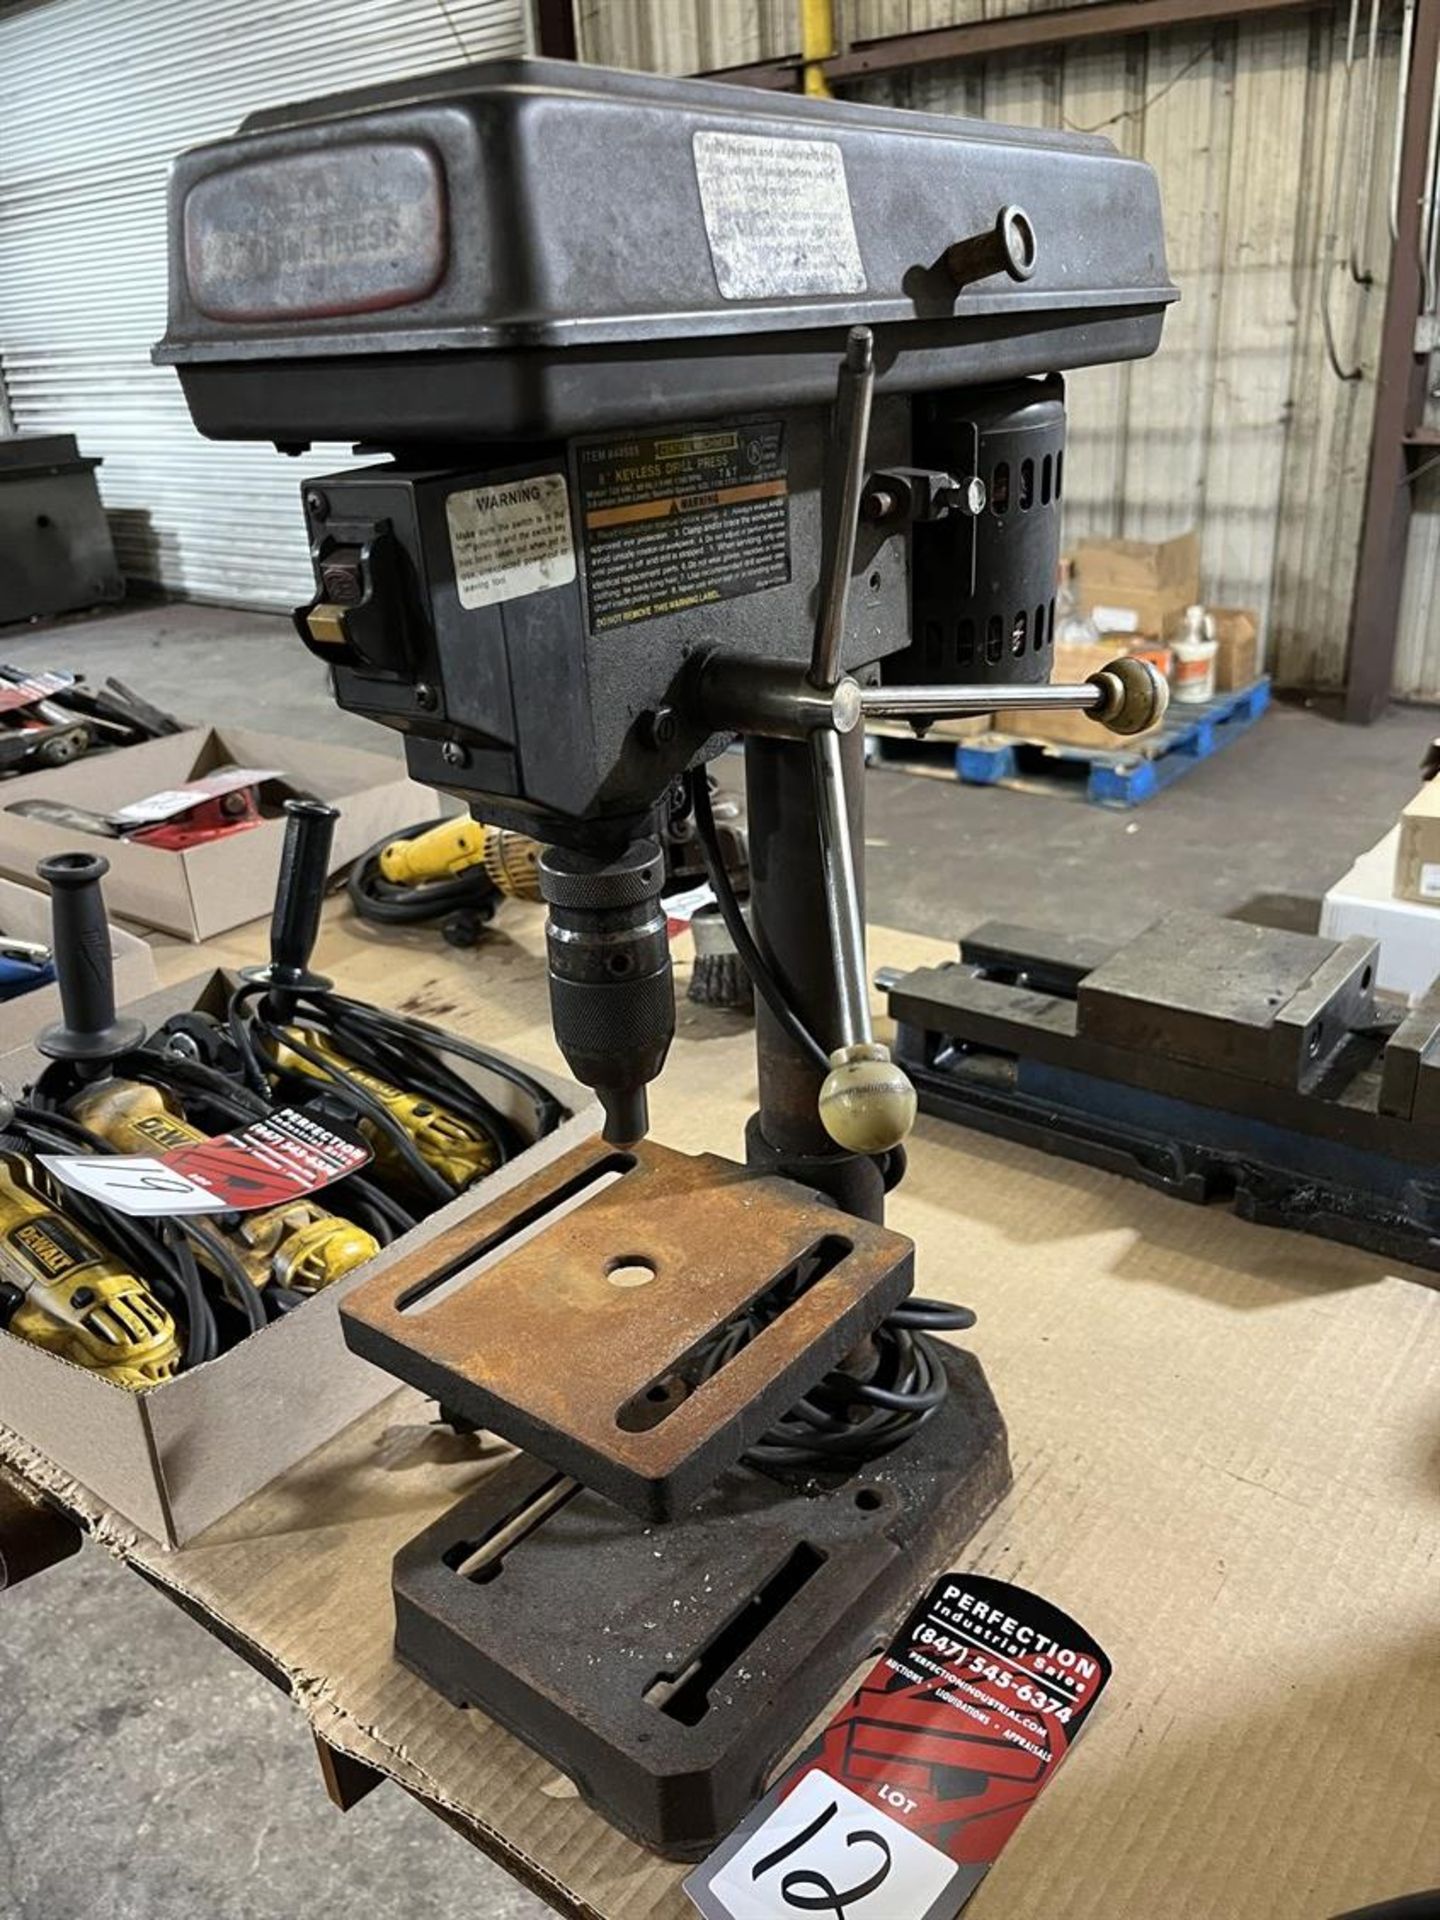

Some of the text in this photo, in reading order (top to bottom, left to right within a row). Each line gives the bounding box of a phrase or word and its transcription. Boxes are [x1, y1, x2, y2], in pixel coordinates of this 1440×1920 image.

[581, 448, 604, 462] ITEM
[614, 463, 661, 482] KEYLESS
[696, 454, 729, 471] PRESS
[476, 486, 541, 511] WARNING
[679, 493, 719, 510] WARNING
[281, 1108, 367, 1158] PERFECTION
[18, 1225, 74, 1275] DEWALT
[933, 1601, 1086, 1693] Industrial Sales
[943, 1585, 1097, 1679] PERFECTION
[908, 1651, 1048, 1738] PERFECTIONINDUSTRIAL.COM
[912, 1623, 1073, 1724] (847) 545-6374
[885, 1658, 1054, 1763] AUCTIONS LIQUIDATIONS APPRAISALS
[878, 1784, 918, 1815] LOT
[752, 1801, 891, 1920] 12
